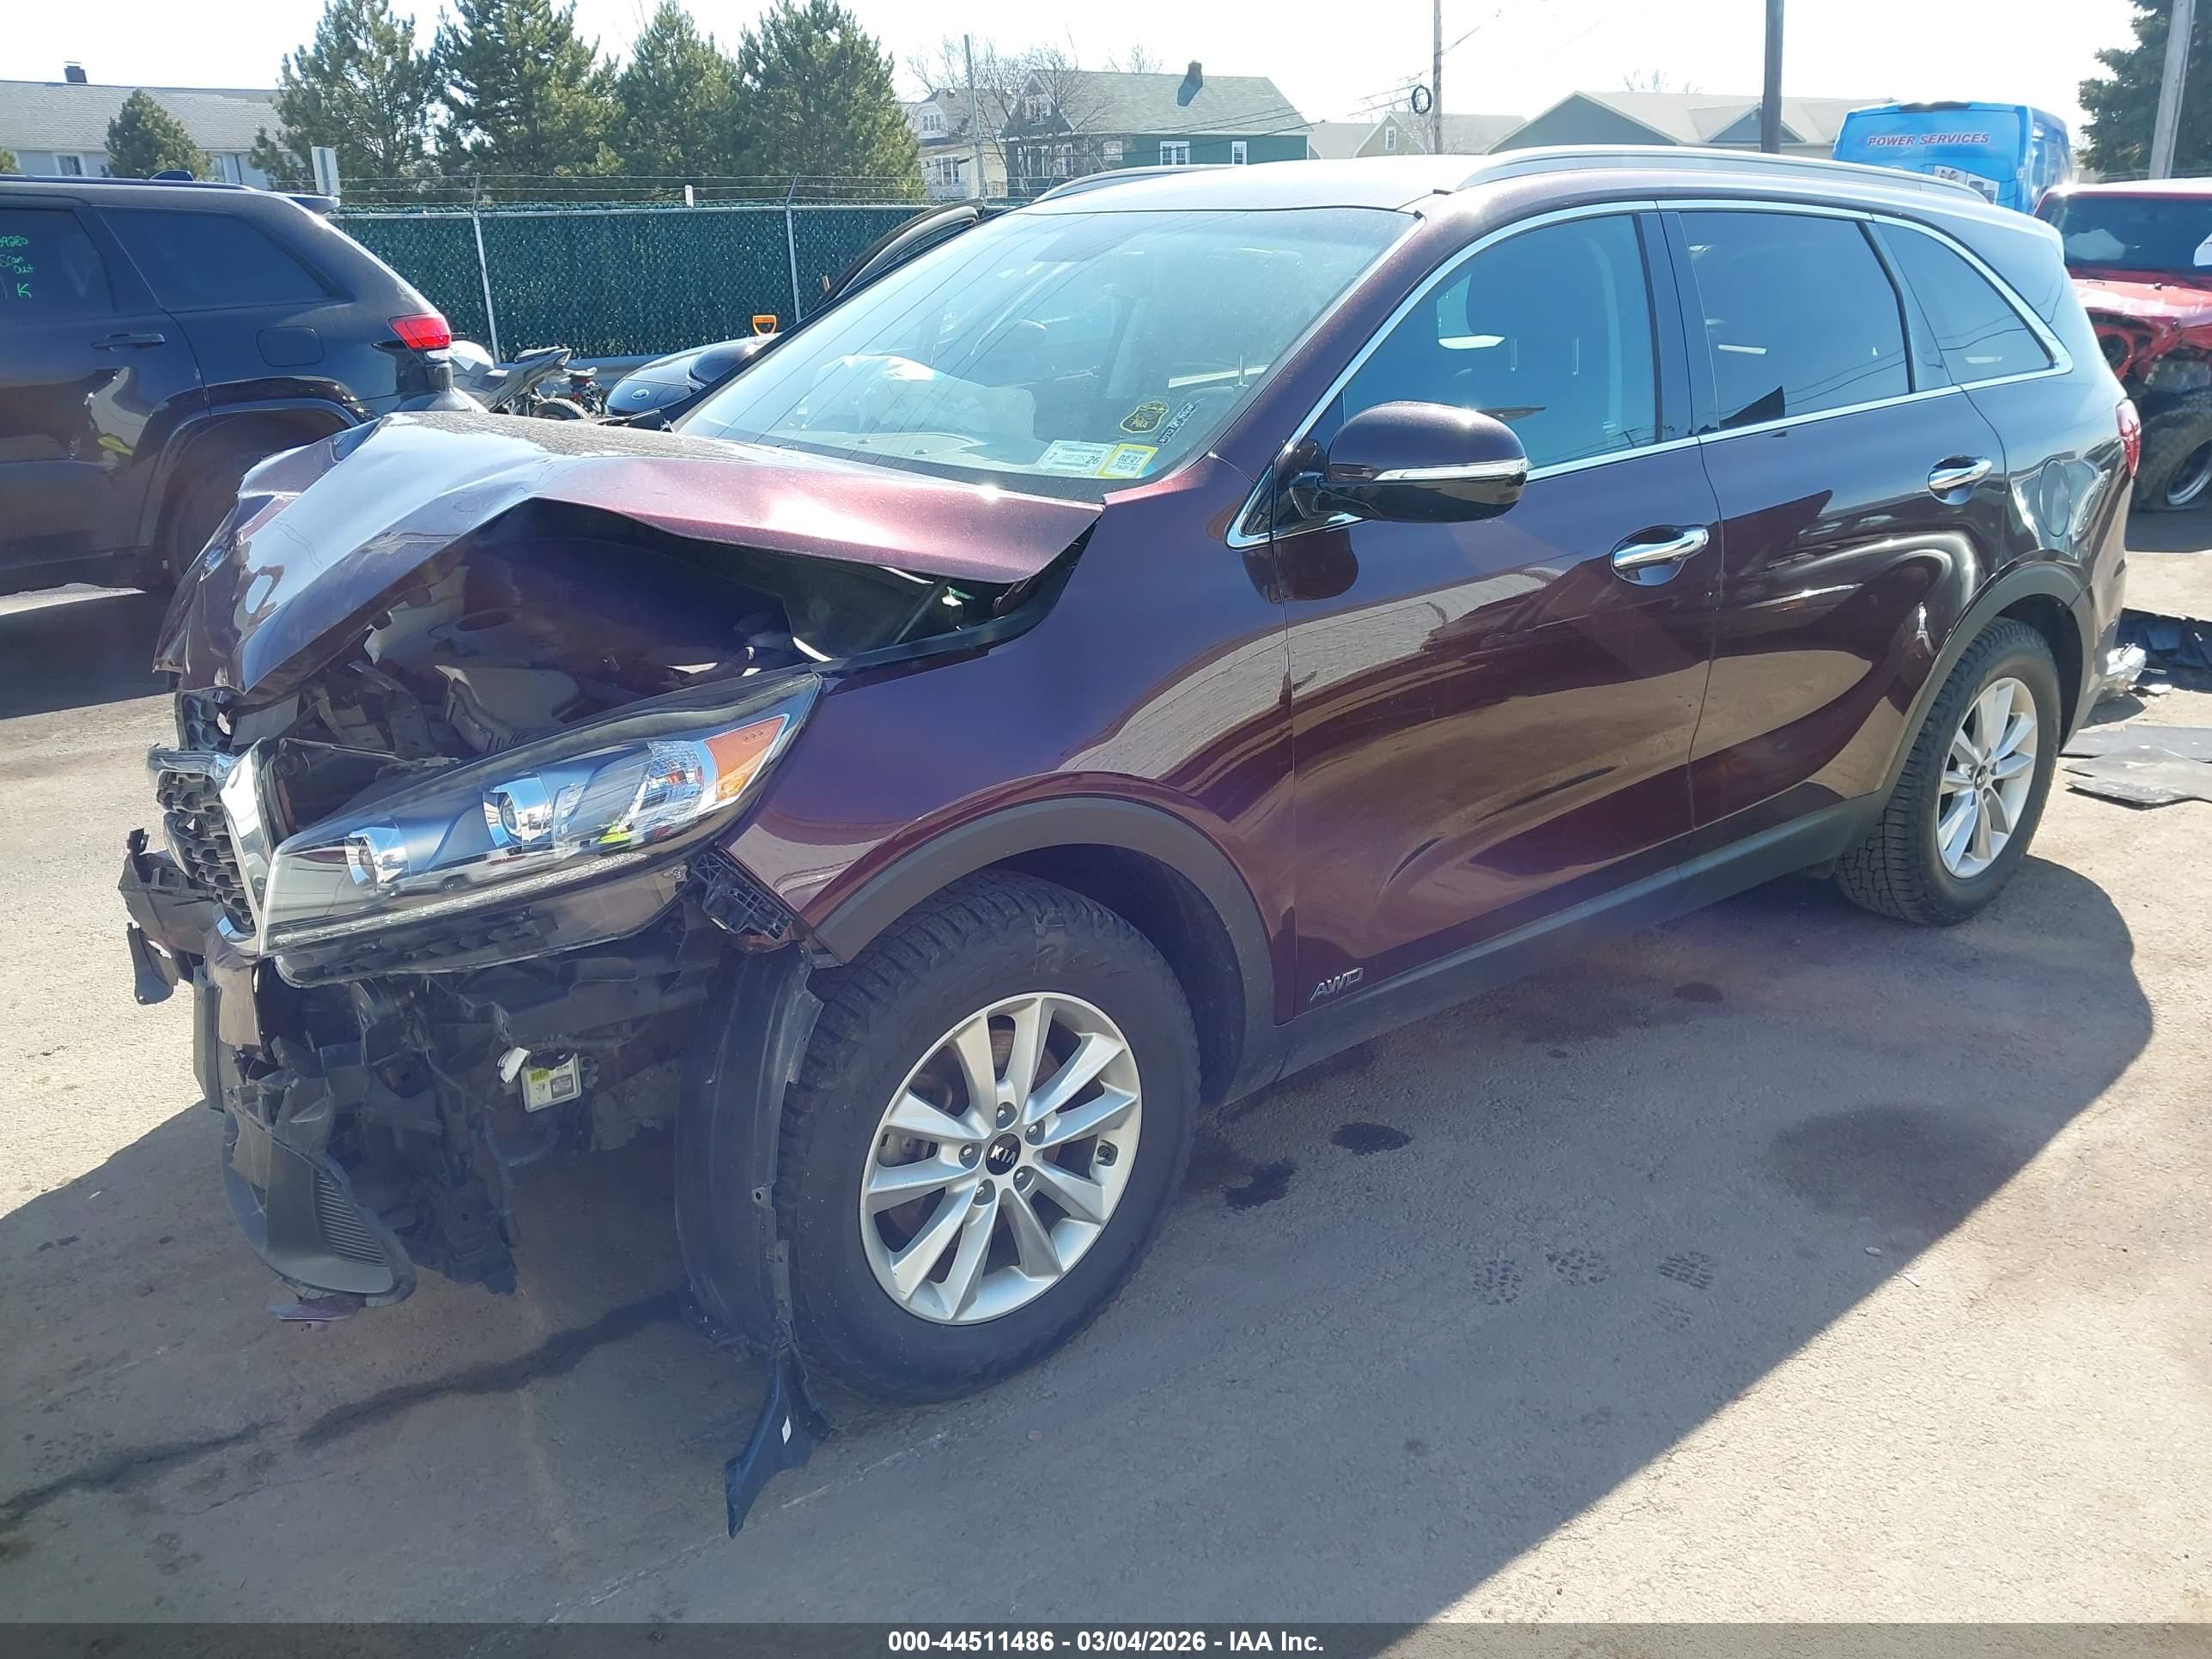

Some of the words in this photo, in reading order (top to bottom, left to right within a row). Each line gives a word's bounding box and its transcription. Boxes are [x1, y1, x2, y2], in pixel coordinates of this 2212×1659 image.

[1868, 136, 1915, 146] POWER
[1919, 132, 1990, 145] SERVICES
[17, 283, 32, 298] K
[1085, 455, 1101, 465] 26
[1310, 967, 1364, 1001] AWD
[990, 1145, 1017, 1165] KIA
